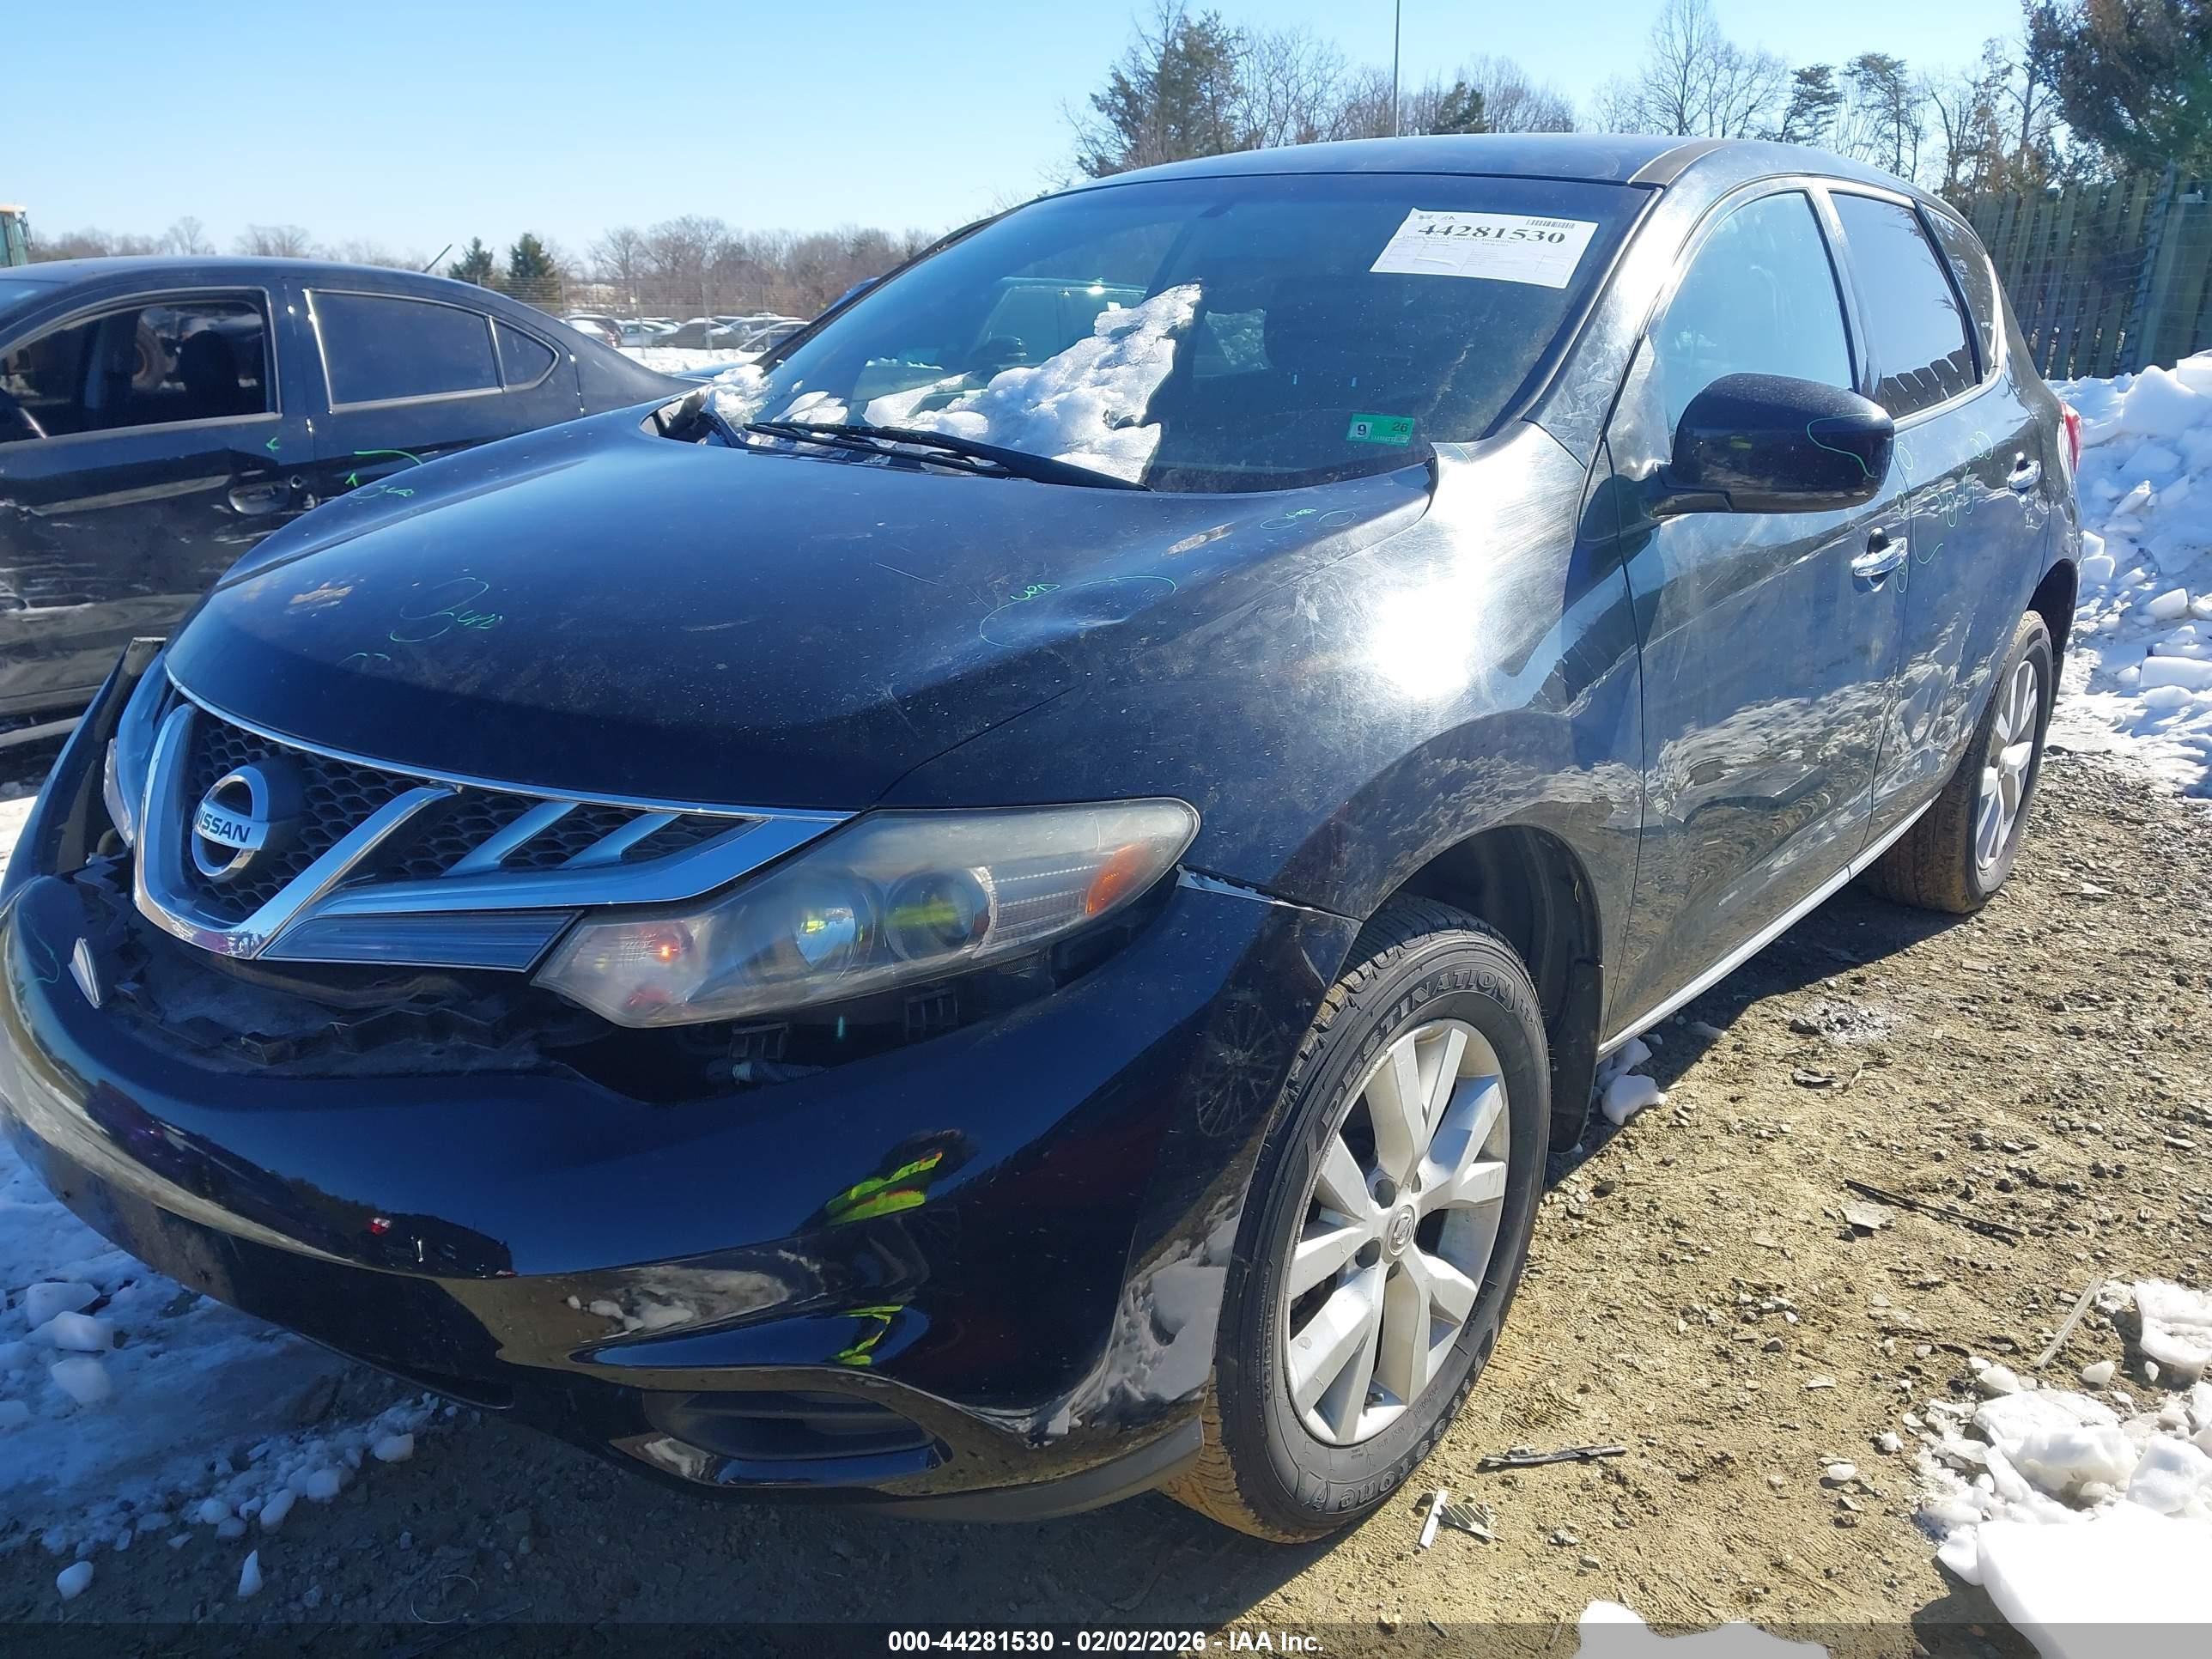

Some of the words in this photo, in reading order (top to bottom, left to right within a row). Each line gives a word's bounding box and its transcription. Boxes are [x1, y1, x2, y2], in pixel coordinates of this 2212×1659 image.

[1418, 224, 1565, 244] 44281530
[1357, 424, 1367, 435] 9
[1393, 422, 1408, 433] 26
[198, 809, 251, 843] NISSAN
[1321, 968, 1512, 1129] DESTINATION
